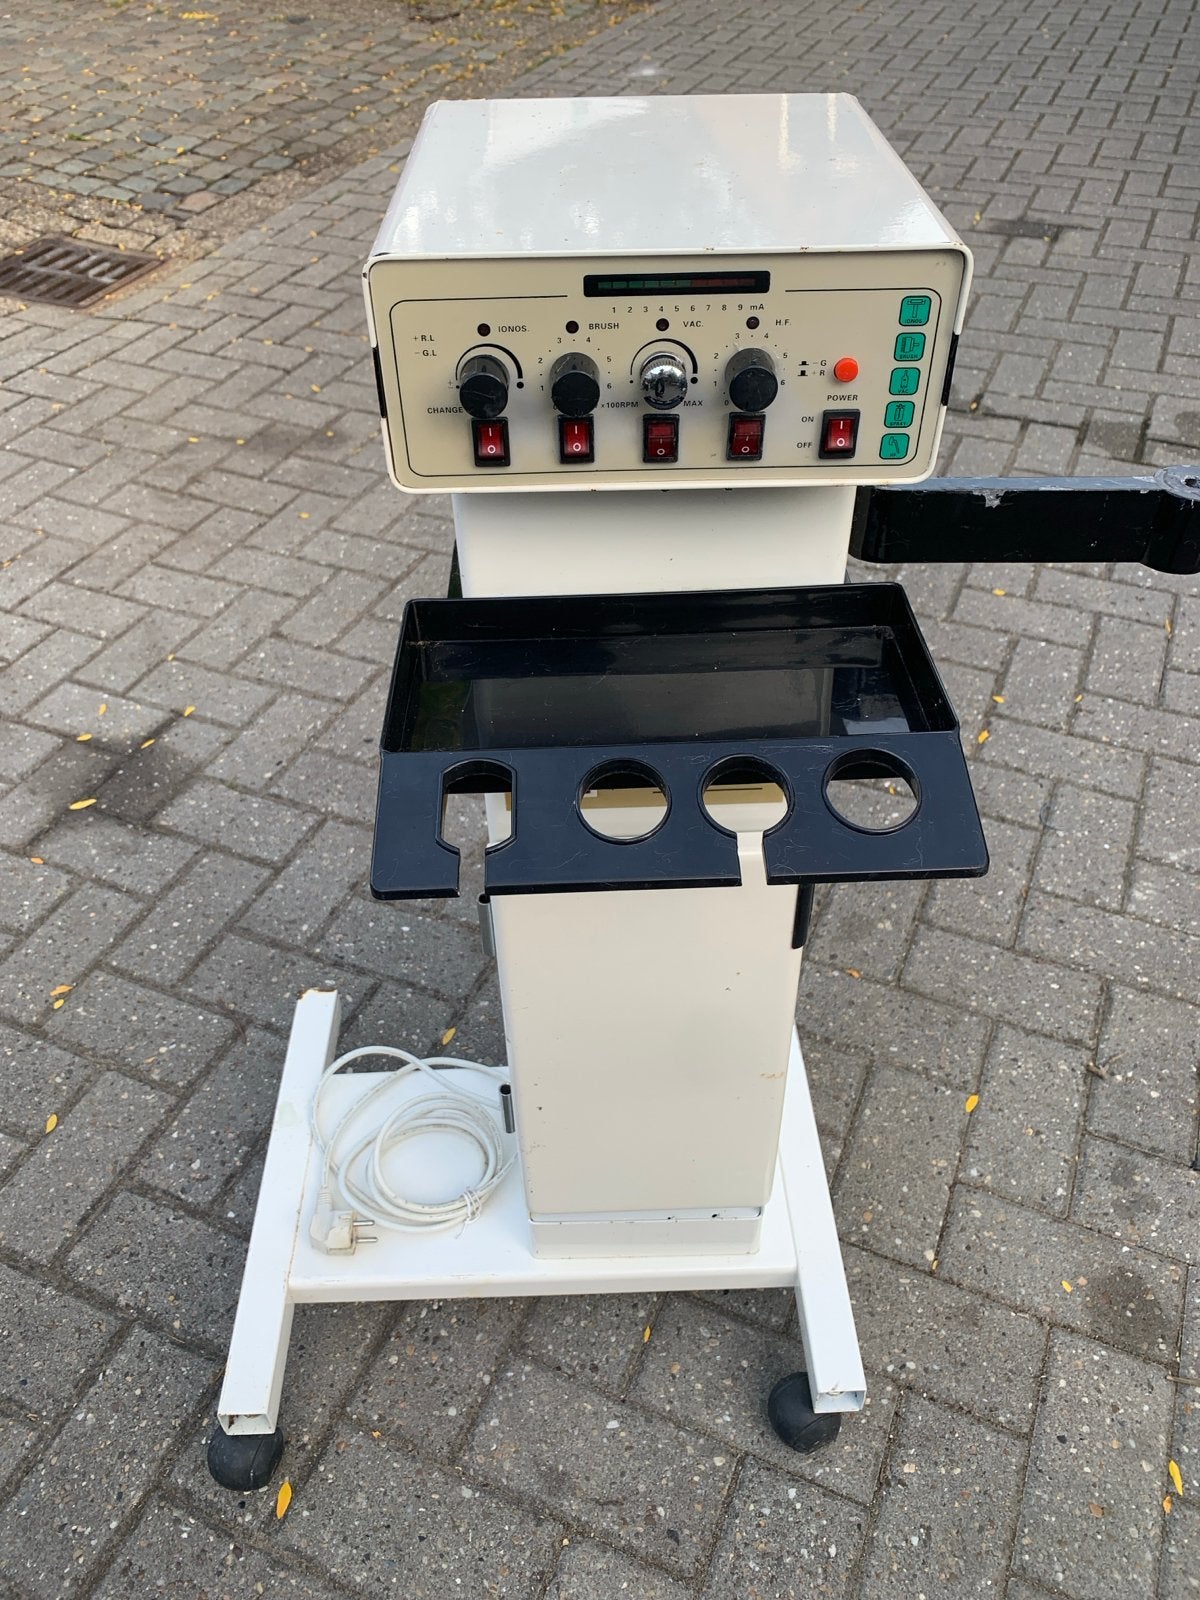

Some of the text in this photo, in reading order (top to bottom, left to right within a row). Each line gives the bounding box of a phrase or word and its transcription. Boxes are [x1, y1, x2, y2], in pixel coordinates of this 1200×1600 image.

[750, 303, 764, 311] mA
[588, 322, 620, 330] BRUSH
[683, 320, 704, 328] VAC.
[827, 394, 858, 402] POWER
[427, 406, 464, 414] CHANGE
